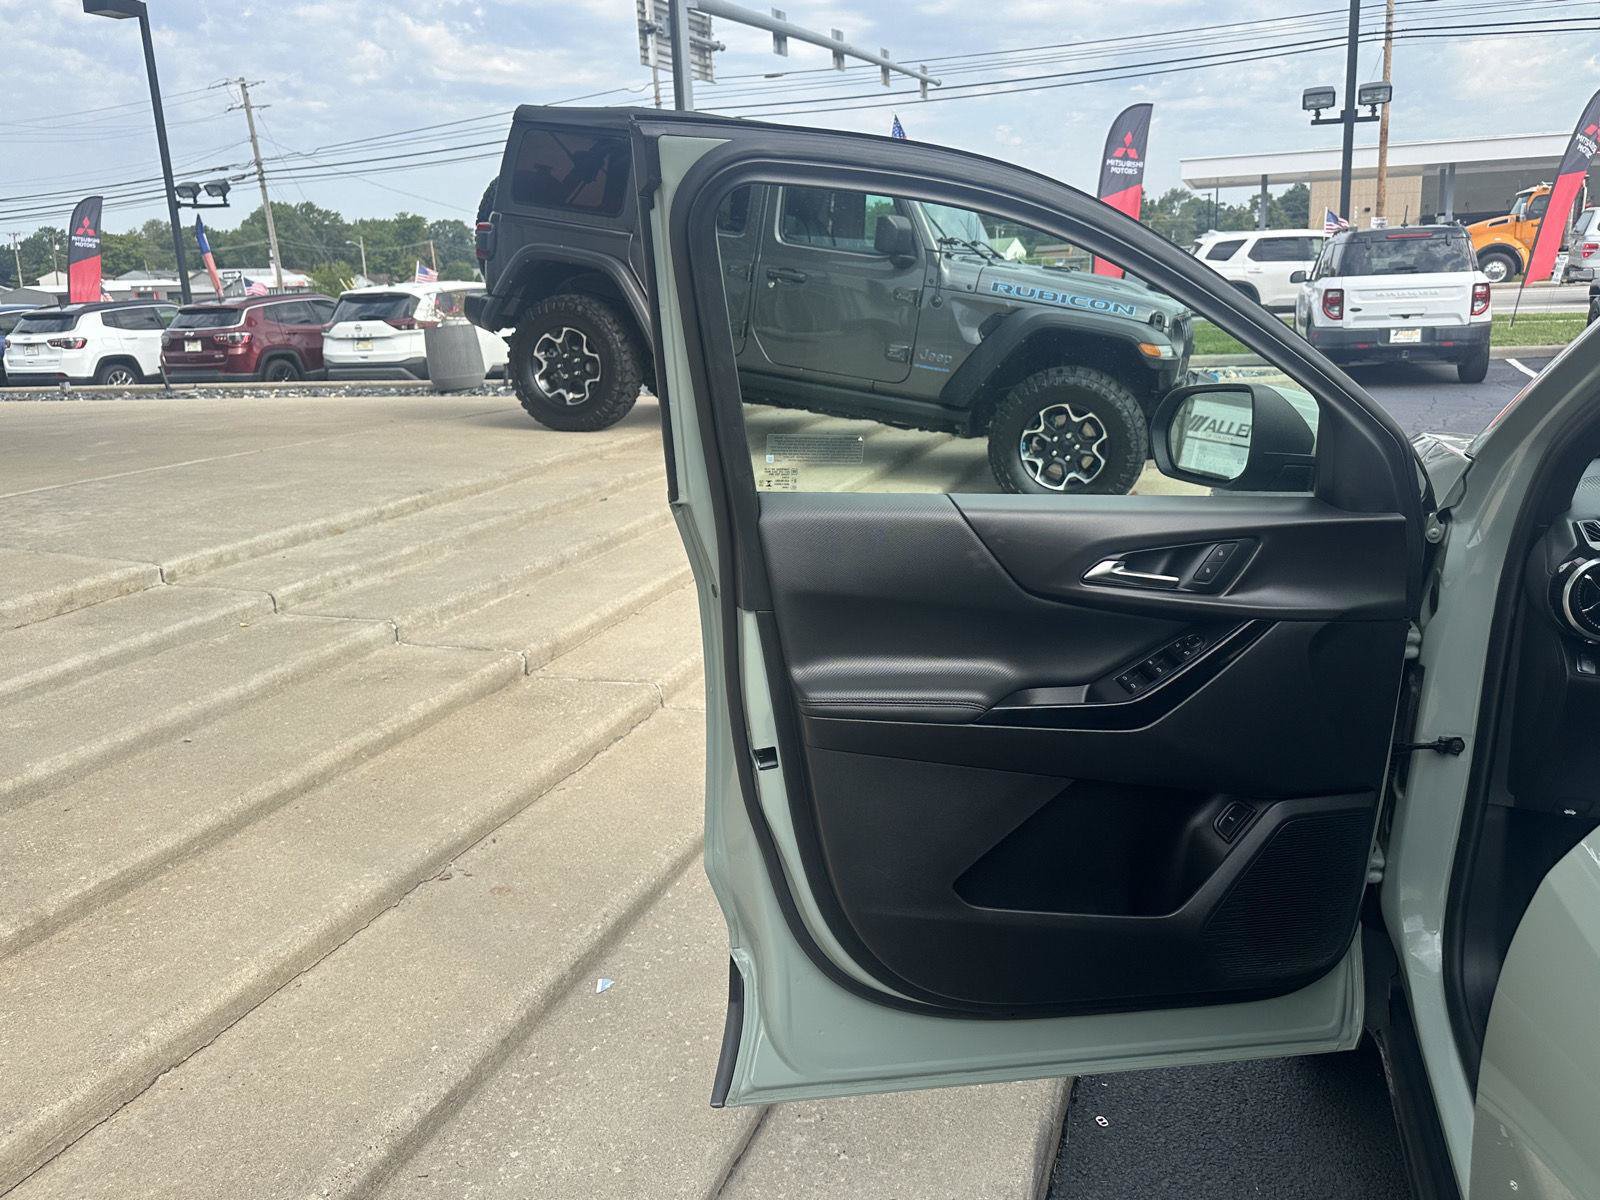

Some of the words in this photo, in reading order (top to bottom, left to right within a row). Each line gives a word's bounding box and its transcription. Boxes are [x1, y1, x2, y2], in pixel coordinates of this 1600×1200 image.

[1106, 159, 1144, 167] MITSUBISHI
[991, 281, 1136, 316] RUBICON
[920, 348, 953, 365] Jeep
[1204, 418, 1251, 438] ALLE
